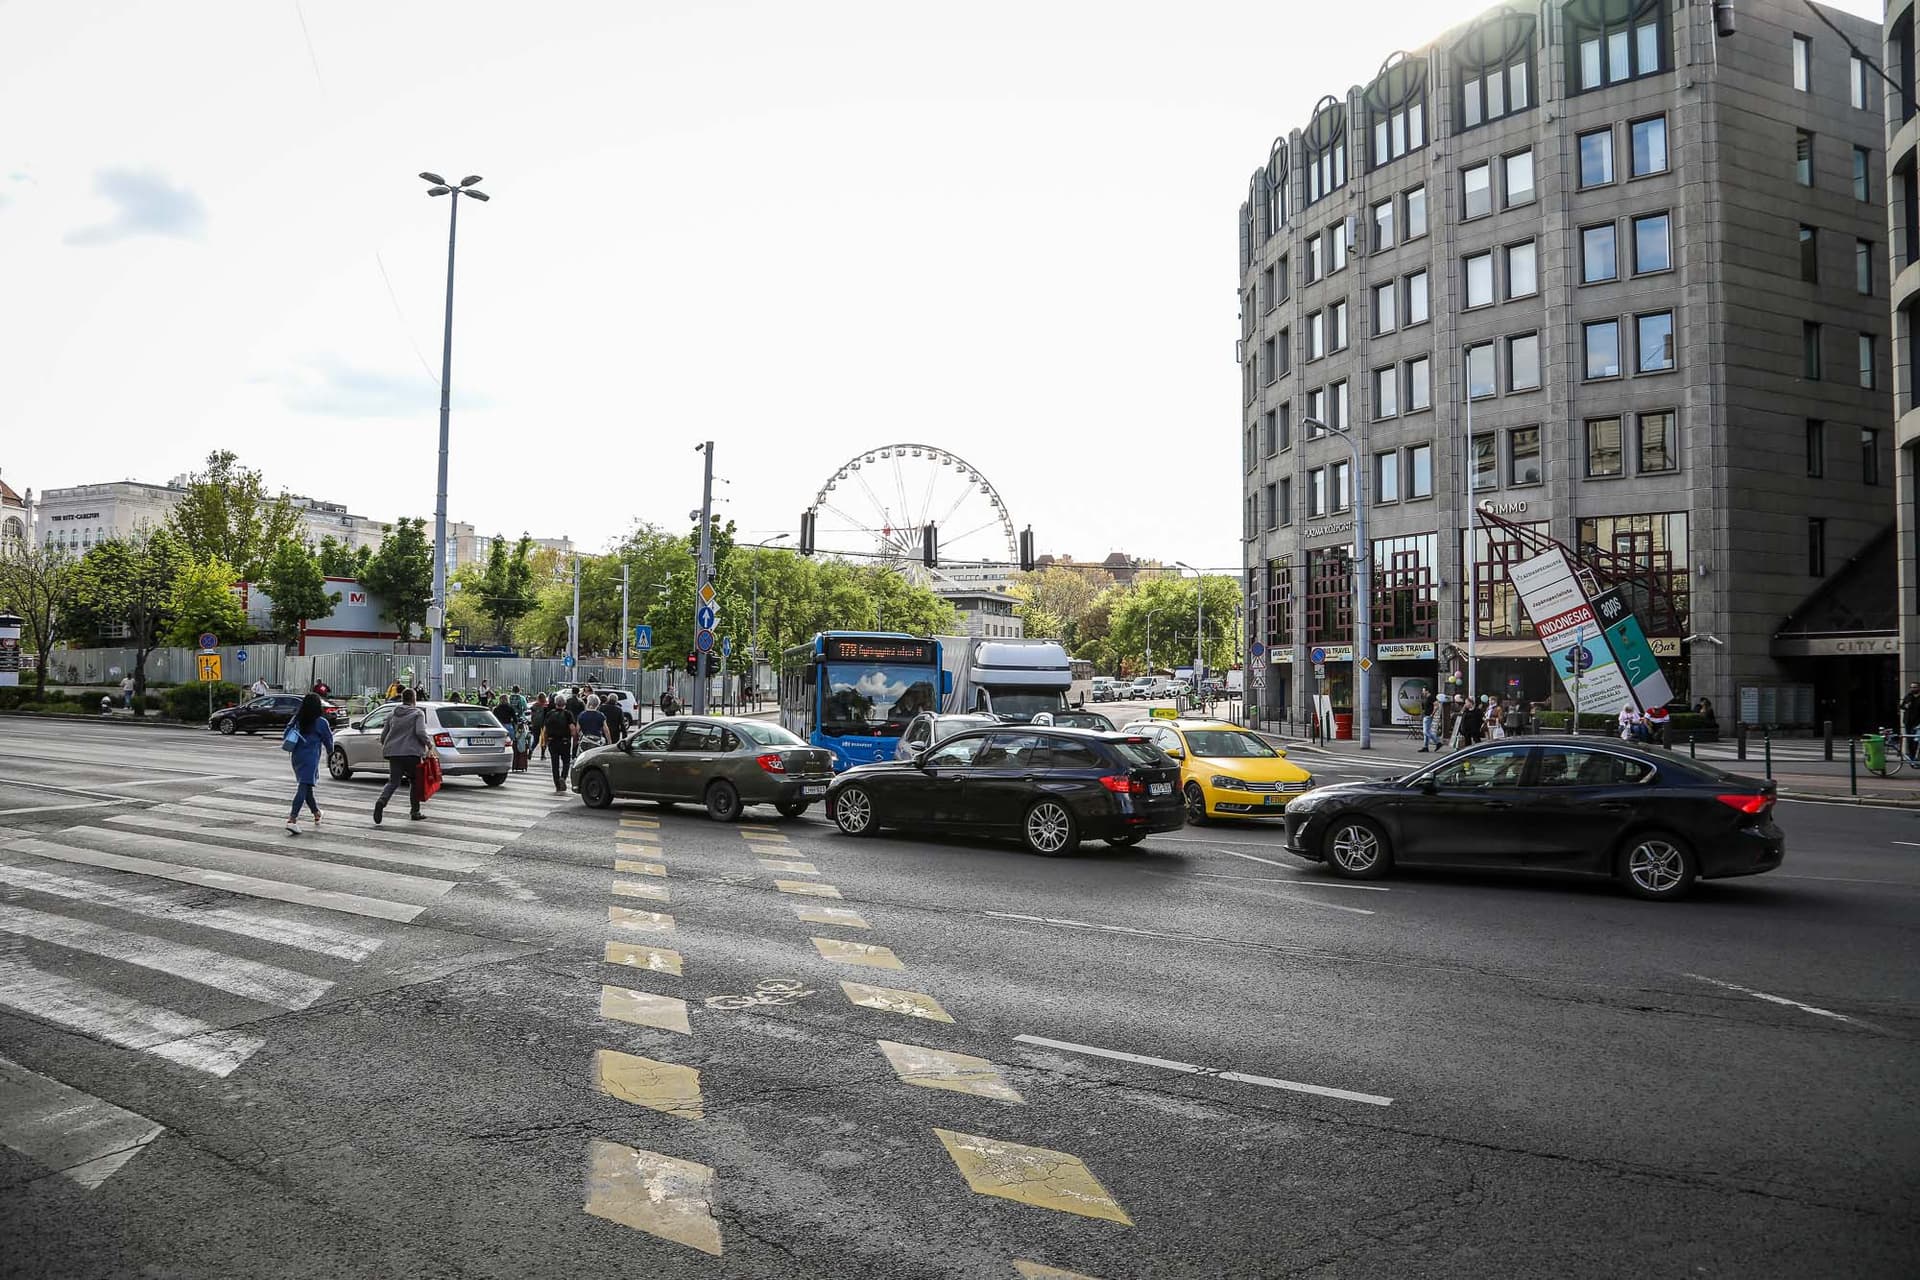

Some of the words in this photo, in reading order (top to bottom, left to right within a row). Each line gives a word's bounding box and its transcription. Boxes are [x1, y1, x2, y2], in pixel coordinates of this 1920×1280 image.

[1600, 596, 1622, 619] apps
[1539, 607, 1592, 636] INDONESIA
[1651, 639, 1676, 653] Bar
[1836, 641, 1876, 651] CITY
